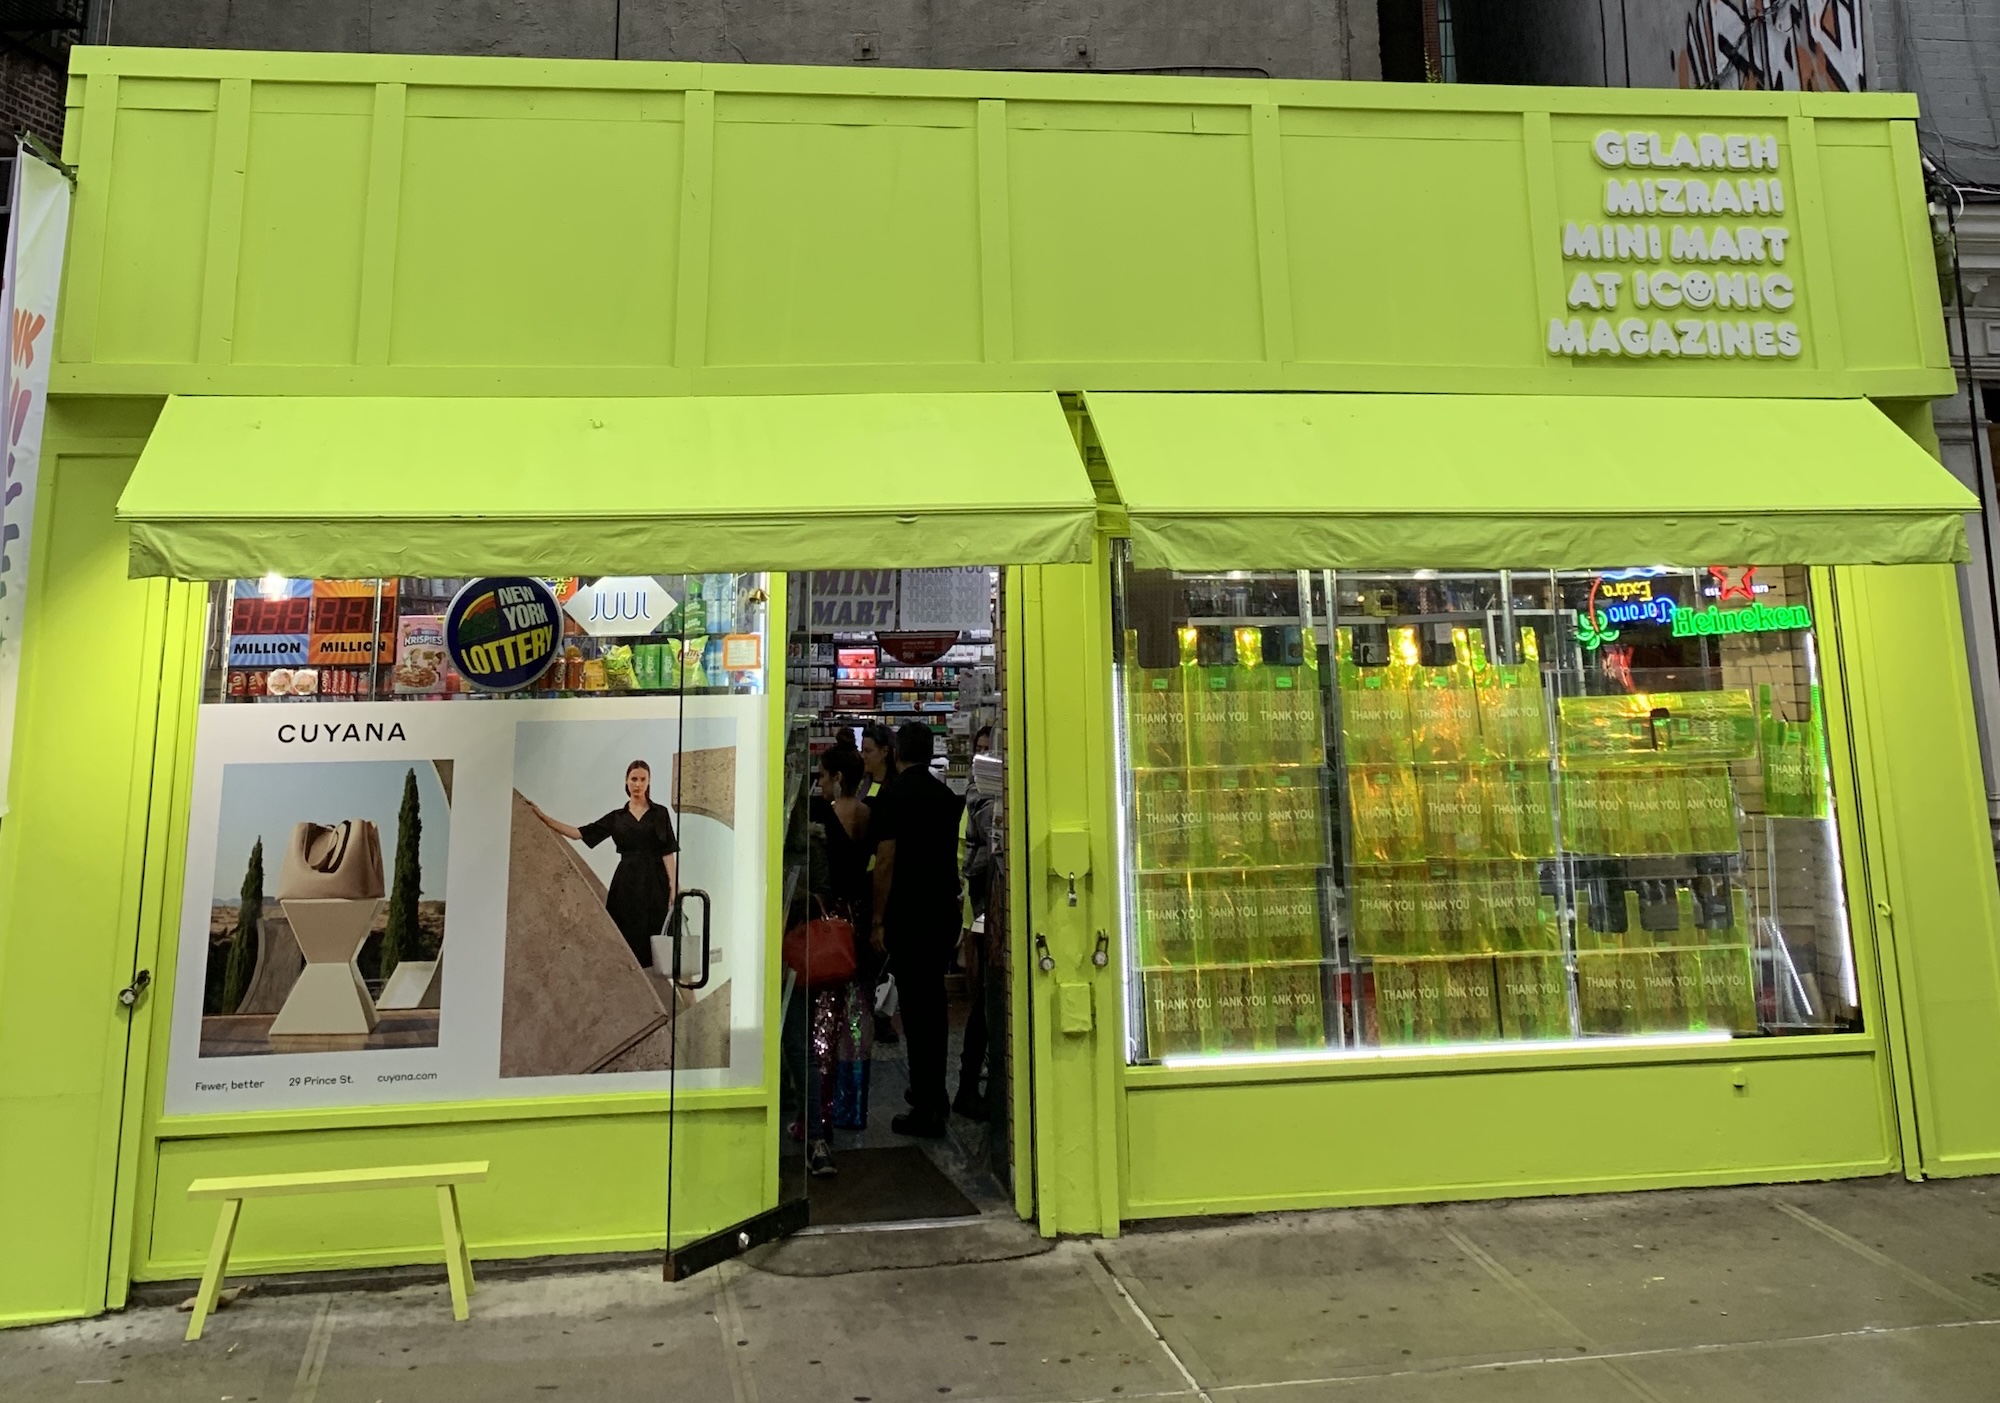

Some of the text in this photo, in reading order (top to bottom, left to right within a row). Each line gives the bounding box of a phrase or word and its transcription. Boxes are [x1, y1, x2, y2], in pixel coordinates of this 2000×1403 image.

[1593, 130, 1779, 170] GELAREH
[1604, 178, 1785, 216] MIZRAHI
[1563, 221, 1789, 263] MINI MART
[1567, 271, 1623, 310] AT
[1548, 318, 1801, 358] MAGAZINES
[812, 570, 893, 596] MINI
[908, 574, 984, 586] THANK YOU
[498, 585, 535, 606] NEW
[1602, 581, 1653, 602] Extra
[589, 591, 651, 621] JUUL
[1608, 597, 1676, 624] Corona
[502, 603, 548, 631] YORK
[812, 600, 895, 626] MART
[1672, 602, 1812, 637] Heineken
[320, 641, 385, 653] MILLION
[404, 636, 443, 646] KRISPIES
[234, 643, 300, 655] MILLION
[461, 624, 554, 675] LOTTERY
[1167, 712, 1185, 723] YO
[1228, 711, 1249, 722] YOU
[1260, 710, 1315, 721] THANK YOU
[1350, 709, 1403, 720] THANK YOU
[1452, 708, 1471, 719] YOU
[1520, 707, 1539, 717] YOU
[277, 722, 406, 743] CUYANA
[1770, 764, 1819, 775] THANK YO
[1428, 803, 1481, 814] THANK YOU
[1492, 804, 1546, 814] THANK YOU
[1600, 799, 1619, 810] YOU
[1627, 799, 1681, 811] THANK YOU
[1687, 798, 1727, 809] ANK YOU
[1146, 813, 1202, 824] THANK YOU
[1241, 812, 1262, 822] YOU
[1293, 809, 1315, 820] YOU
[1360, 899, 1415, 910] THANK YOU
[1421, 899, 1470, 910] HANK YOU
[1516, 896, 1535, 906] YOU
[1146, 909, 1202, 920] THANK YOU
[1235, 906, 1258, 917] YOU
[1263, 904, 1312, 916] HANK YOU
[1586, 976, 1617, 989] THANK
[1643, 975, 1697, 988] THANK YOU
[1703, 974, 1745, 986] ANK YOU
[1383, 987, 1439, 1000] THANK YOU
[1468, 986, 1489, 997] YOU
[1506, 983, 1560, 995] THANK YOU
[1154, 998, 1212, 1011] THANK YOU
[1245, 996, 1266, 1006] YOU
[1272, 994, 1315, 1005] ANK YOU
[288, 1075, 354, 1087] 29 Prince St.
[377, 1072, 438, 1085] cuyana.com
[195, 1079, 265, 1092] Fewer, better
